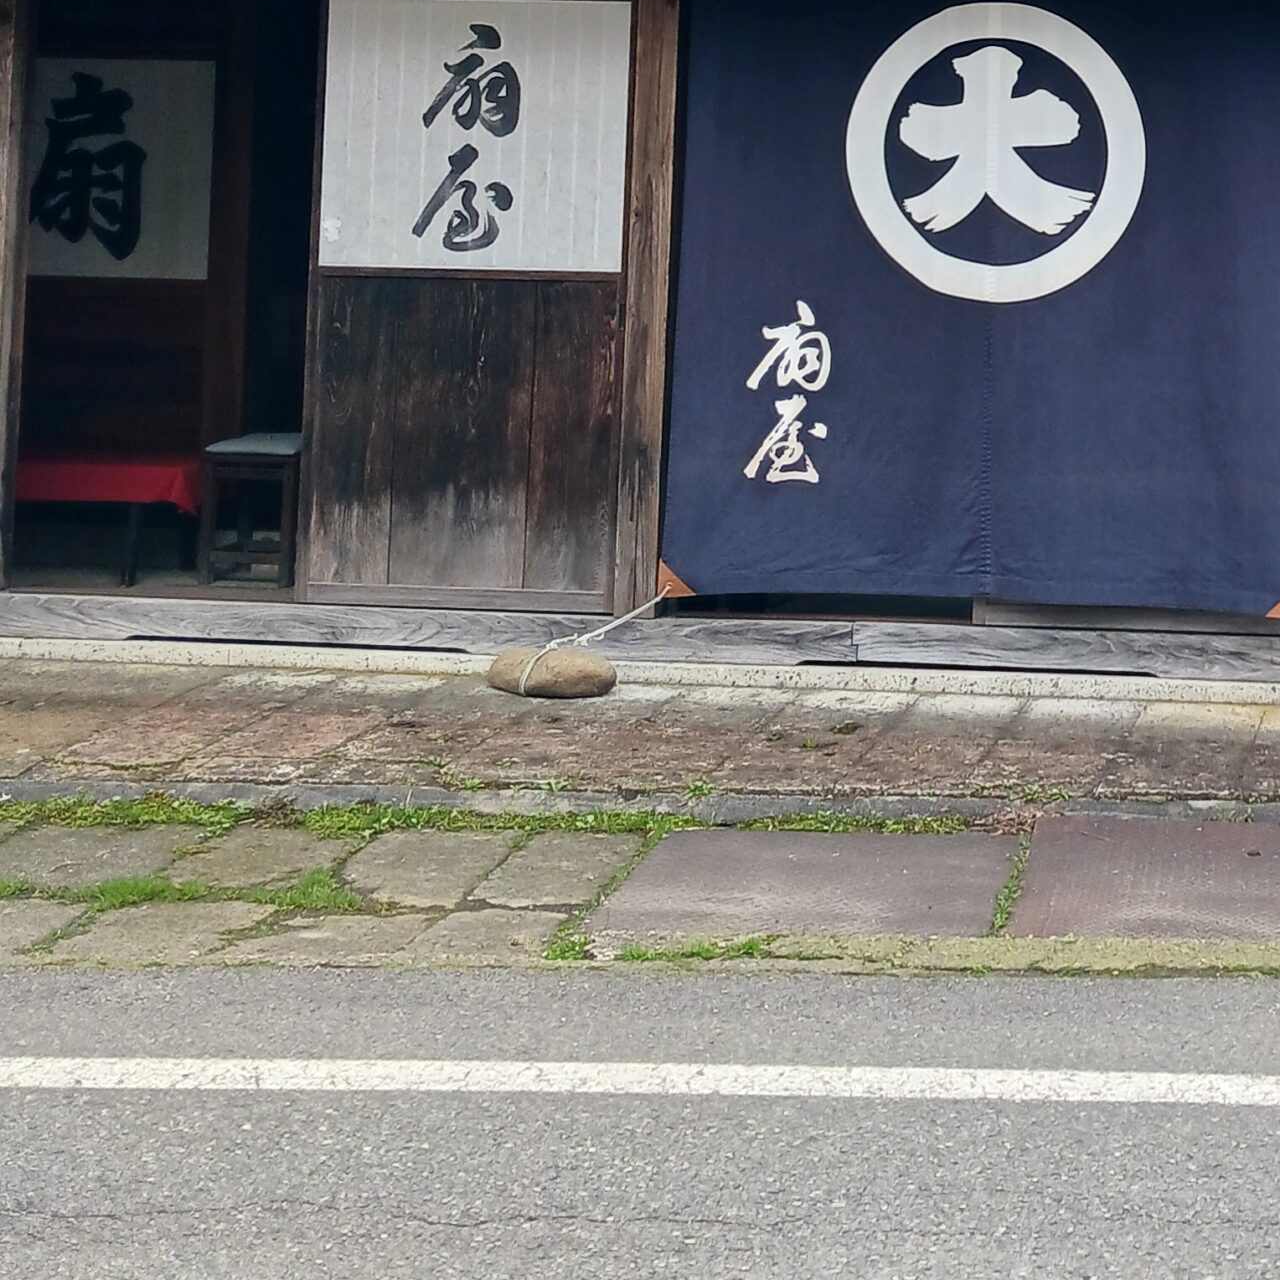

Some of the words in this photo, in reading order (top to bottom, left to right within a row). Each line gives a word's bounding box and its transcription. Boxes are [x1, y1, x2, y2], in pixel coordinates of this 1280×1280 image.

[29, 72, 147, 261] 扇
[412, 24, 521, 251] 扇屋
[899, 45, 1096, 236] 大
[744, 301, 831, 483] 扇屋
